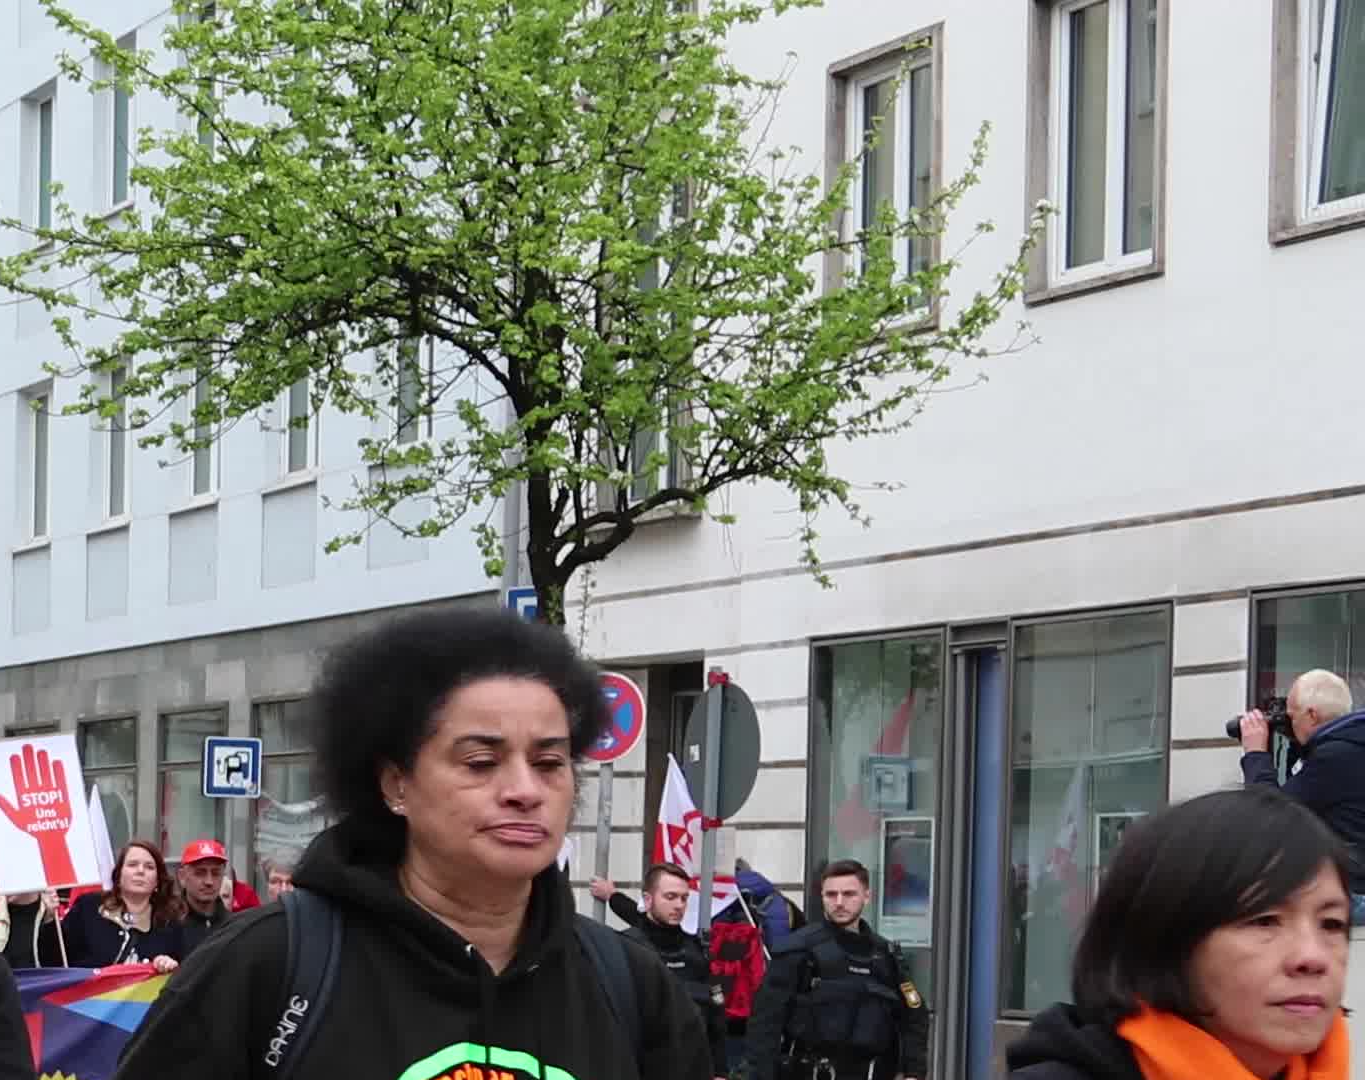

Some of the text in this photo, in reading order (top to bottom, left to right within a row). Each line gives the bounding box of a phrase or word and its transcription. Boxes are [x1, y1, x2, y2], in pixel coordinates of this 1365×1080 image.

[20, 789, 63, 807] STOP!
[36, 808, 57, 819] Uns
[27, 817, 69, 832] reicht's!
